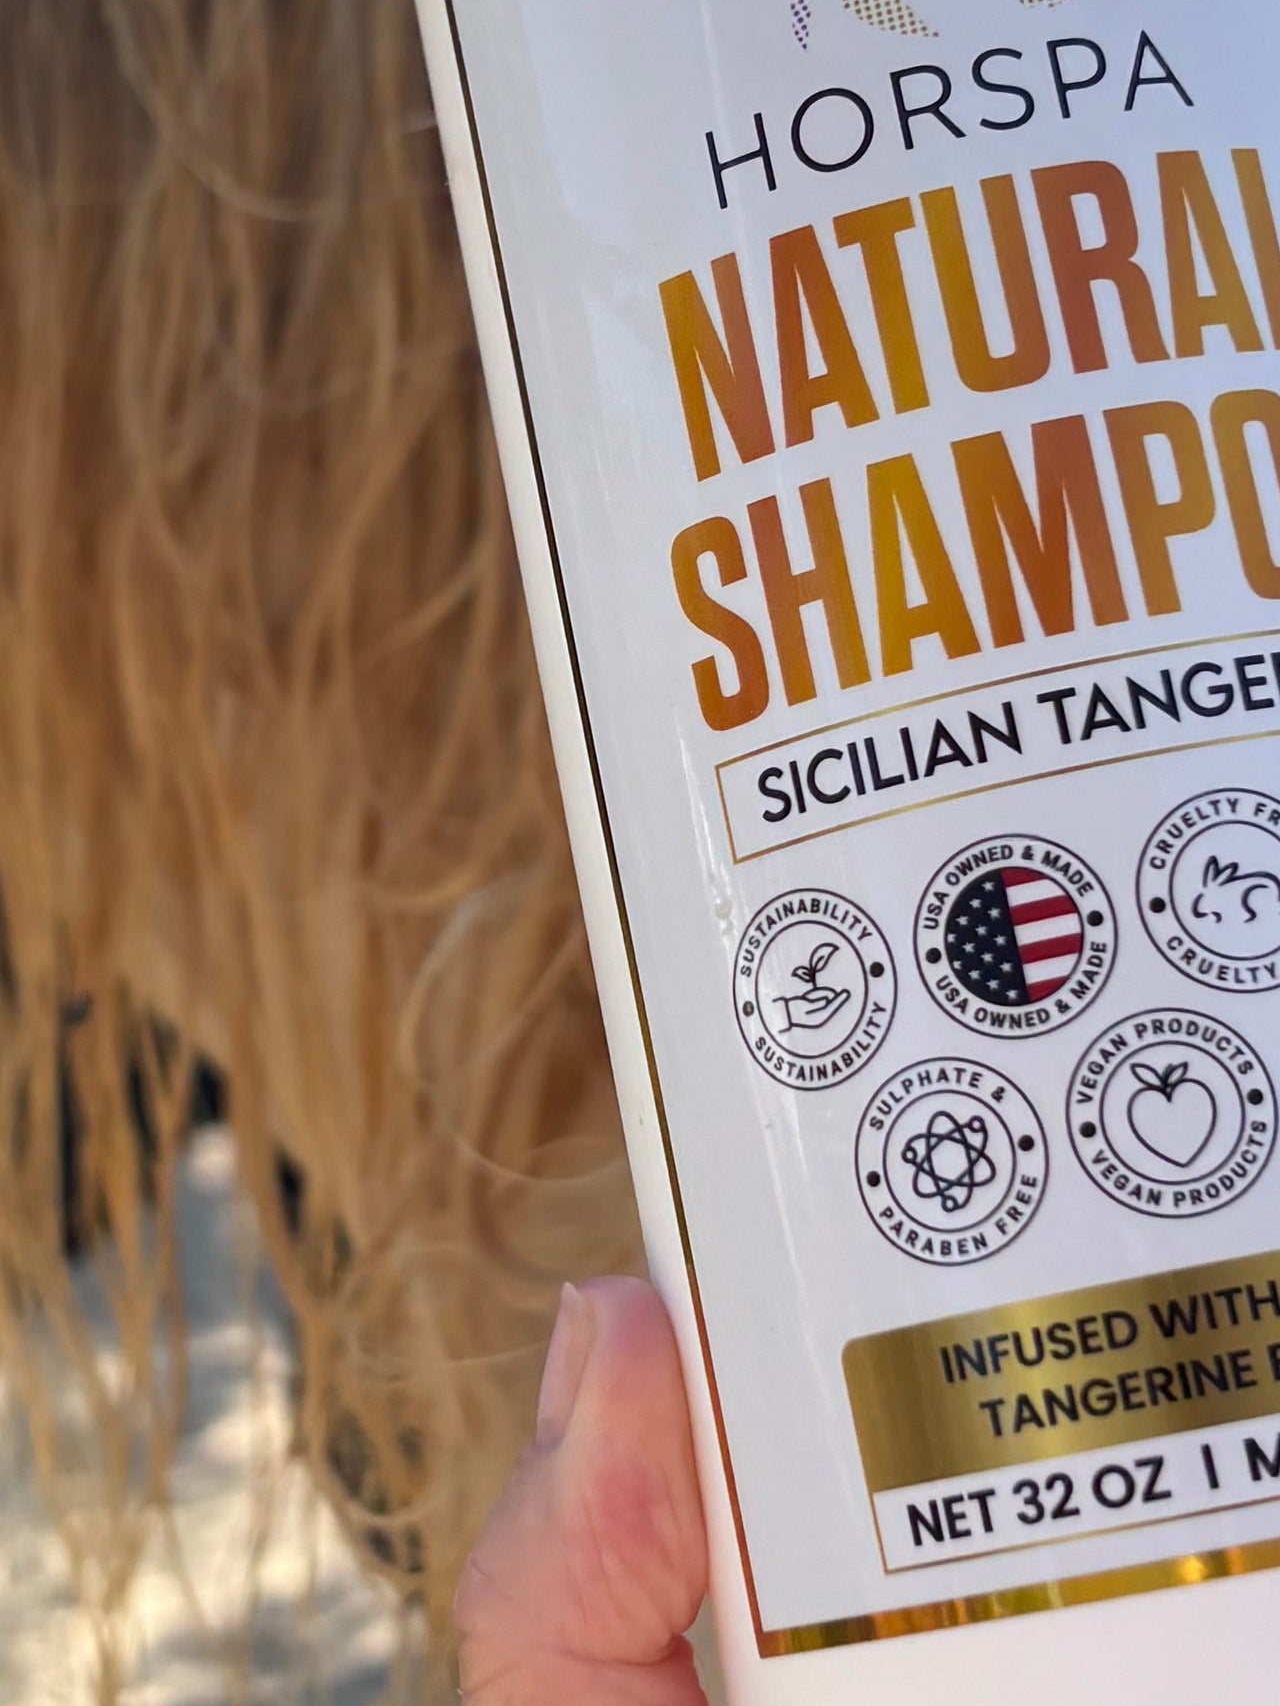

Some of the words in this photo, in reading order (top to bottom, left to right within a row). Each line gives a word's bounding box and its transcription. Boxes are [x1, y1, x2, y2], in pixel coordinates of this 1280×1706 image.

[705, 30, 1194, 209] HORSPA
[757, 701, 1023, 824] SICILIAN
[1149, 797, 1239, 870] CRUELTY
[923, 890, 950, 931] USA
[945, 844, 1014, 886] OWNED
[1020, 845, 1035, 861] &
[1040, 850, 1095, 898] MADE
[740, 897, 873, 978] SUSTAINABILITY
[1166, 935, 1277, 984] CRUELTY
[935, 974, 970, 1014] USA
[973, 1007, 1051, 1030] OWNED
[1054, 998, 1073, 1014] &
[1069, 941, 1108, 1000] MADE
[755, 1001, 887, 1083] SUSTAINABILITY
[1076, 1033, 1129, 1105] VEGAN
[1134, 1018, 1255, 1076] PRODUCTS
[869, 1067, 984, 1131] SULPHATE
[990, 1086, 1006, 1104] &
[1091, 1149, 1163, 1207] VEGAN
[1172, 1120, 1268, 1208] PRODUCTS
[879, 1206, 989, 1256] PARABEN
[994, 1174, 1038, 1235] FREE
[939, 1309, 1139, 1384] INFUSED
[979, 1348, 1258, 1438] TANGERINE
[906, 1488, 996, 1546] NET
[1012, 1471, 1081, 1525] 32
[1091, 1455, 1173, 1509] OZ
